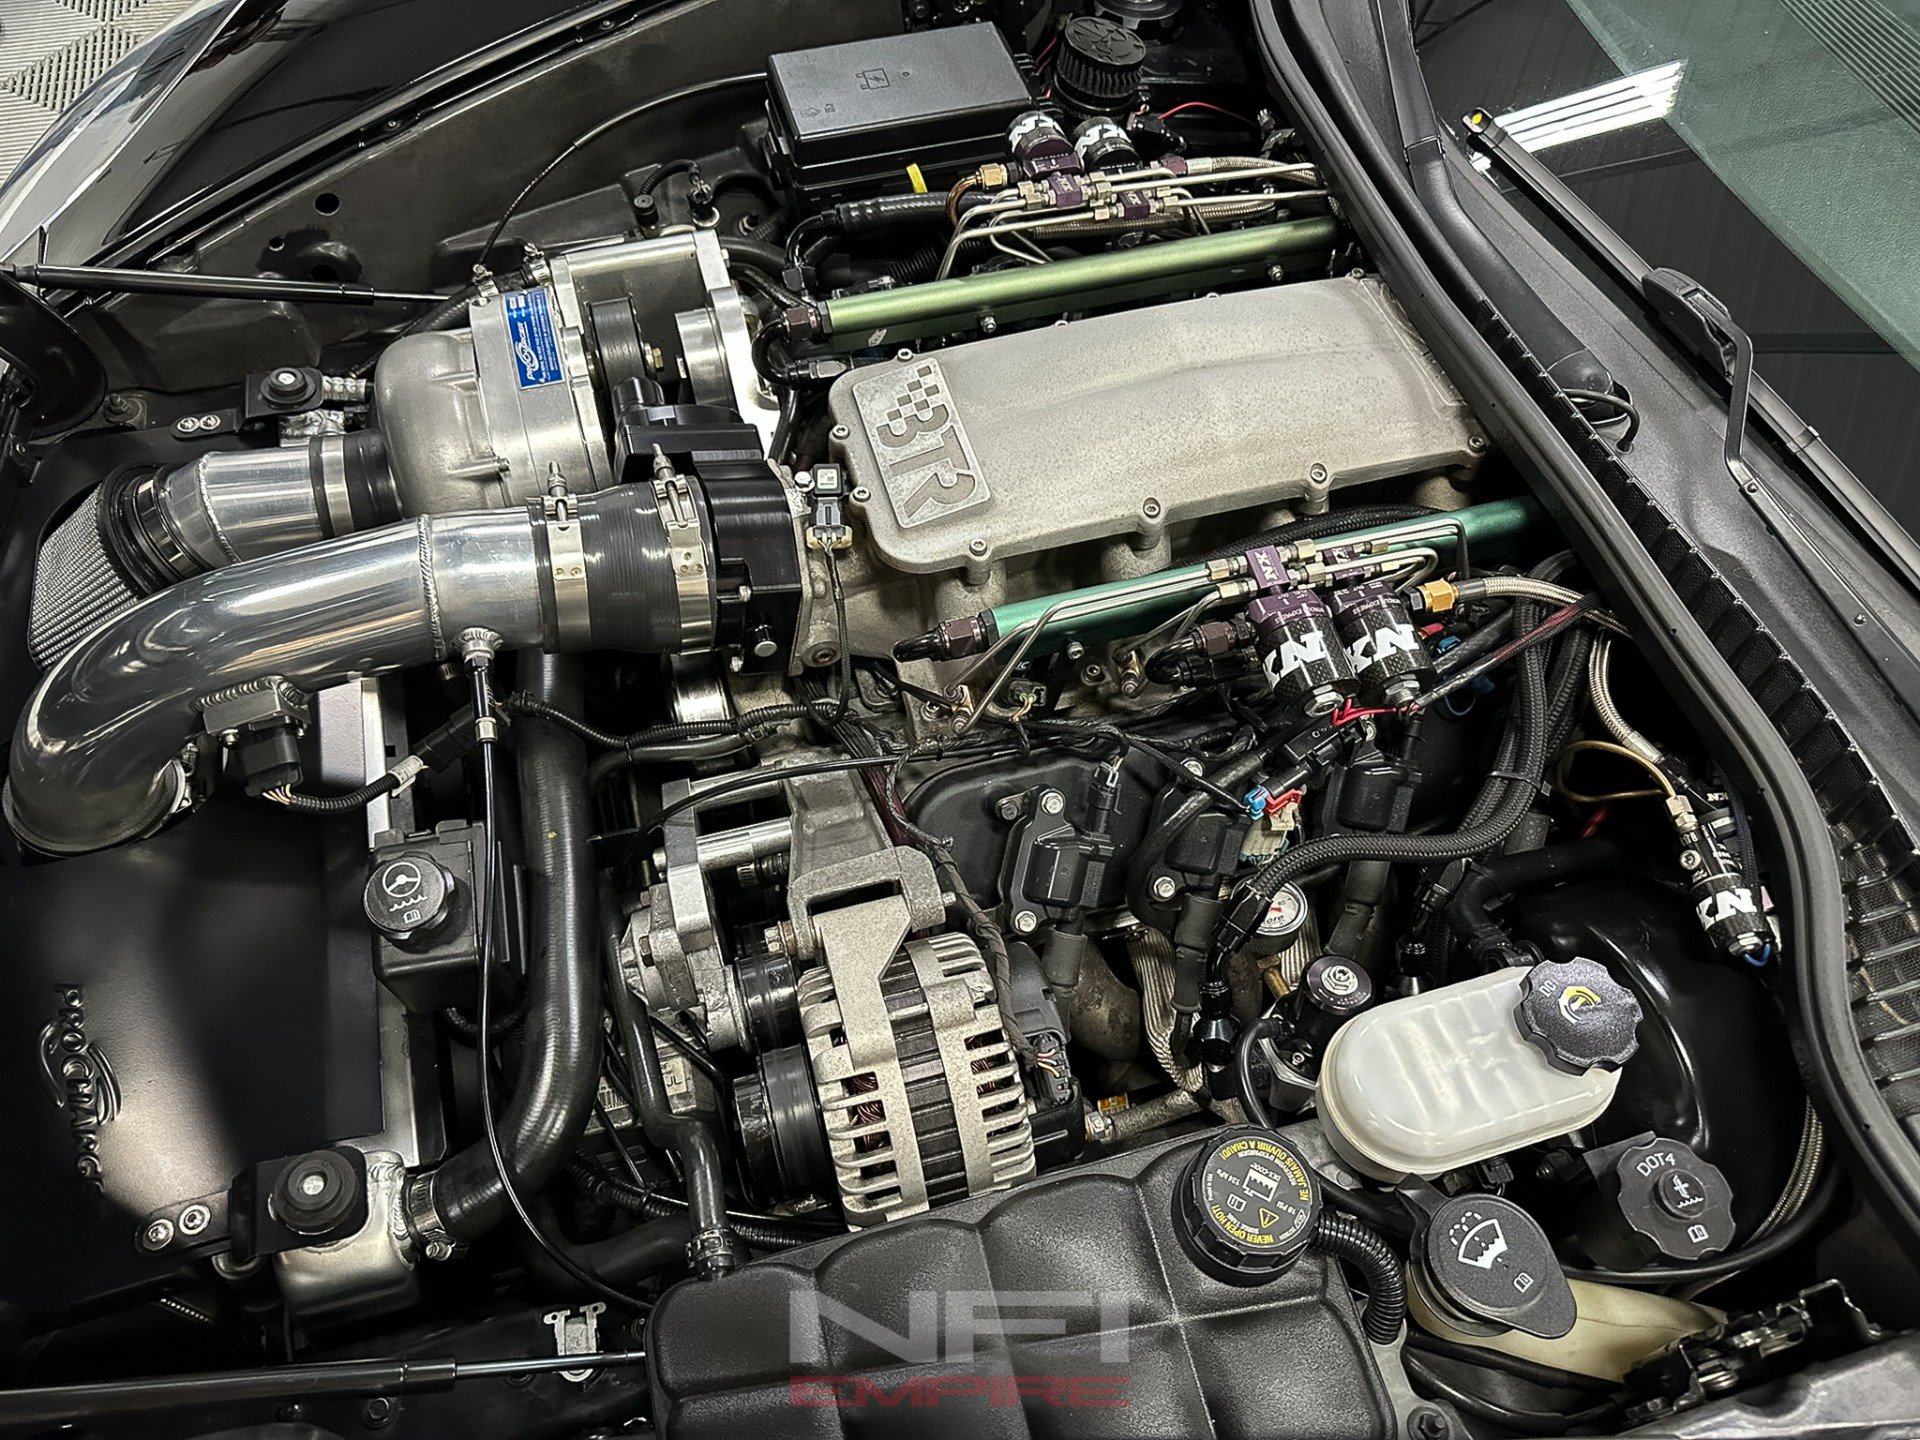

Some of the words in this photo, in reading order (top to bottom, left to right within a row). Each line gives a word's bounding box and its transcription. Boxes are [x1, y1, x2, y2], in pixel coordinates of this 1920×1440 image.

[1256, 550, 1278, 581] NX
[667, 1076, 682, 1087] JL
[1218, 1140, 1248, 1160] CHAUD!
[1257, 1141, 1287, 1160] OUVRIR
[1227, 1174, 1240, 1186] 124
[1285, 1157, 1308, 1188] JAMAIS
[1211, 1204, 1228, 1224] HOT!
[1275, 1200, 1289, 1211] PSI
[1226, 1222, 1246, 1238] OPEN
[1247, 1234, 1274, 1244] NEVER
